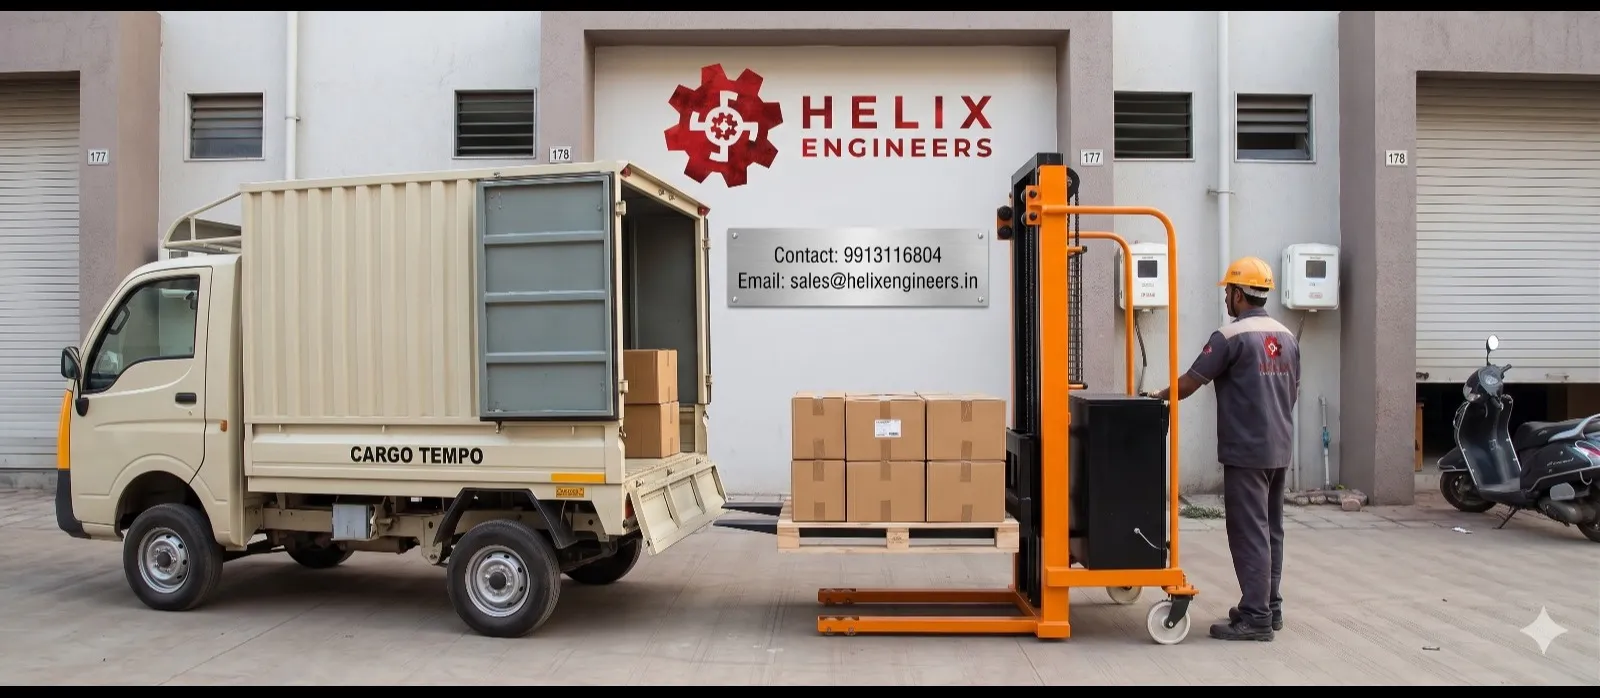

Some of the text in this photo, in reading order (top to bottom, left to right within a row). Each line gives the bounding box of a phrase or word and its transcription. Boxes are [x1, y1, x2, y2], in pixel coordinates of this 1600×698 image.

[801, 95, 992, 130] HELIX
[90, 151, 106, 162] 177
[552, 149, 570, 160] 178
[801, 137, 993, 159] ENGINEERS
[1084, 152, 1101, 163] 177
[1389, 153, 1405, 164] 178
[774, 246, 942, 264] Contact: 9913116804
[738, 271, 978, 293] Email: sales@helixengineers.in
[350, 445, 484, 465] CARGO TEMPO
